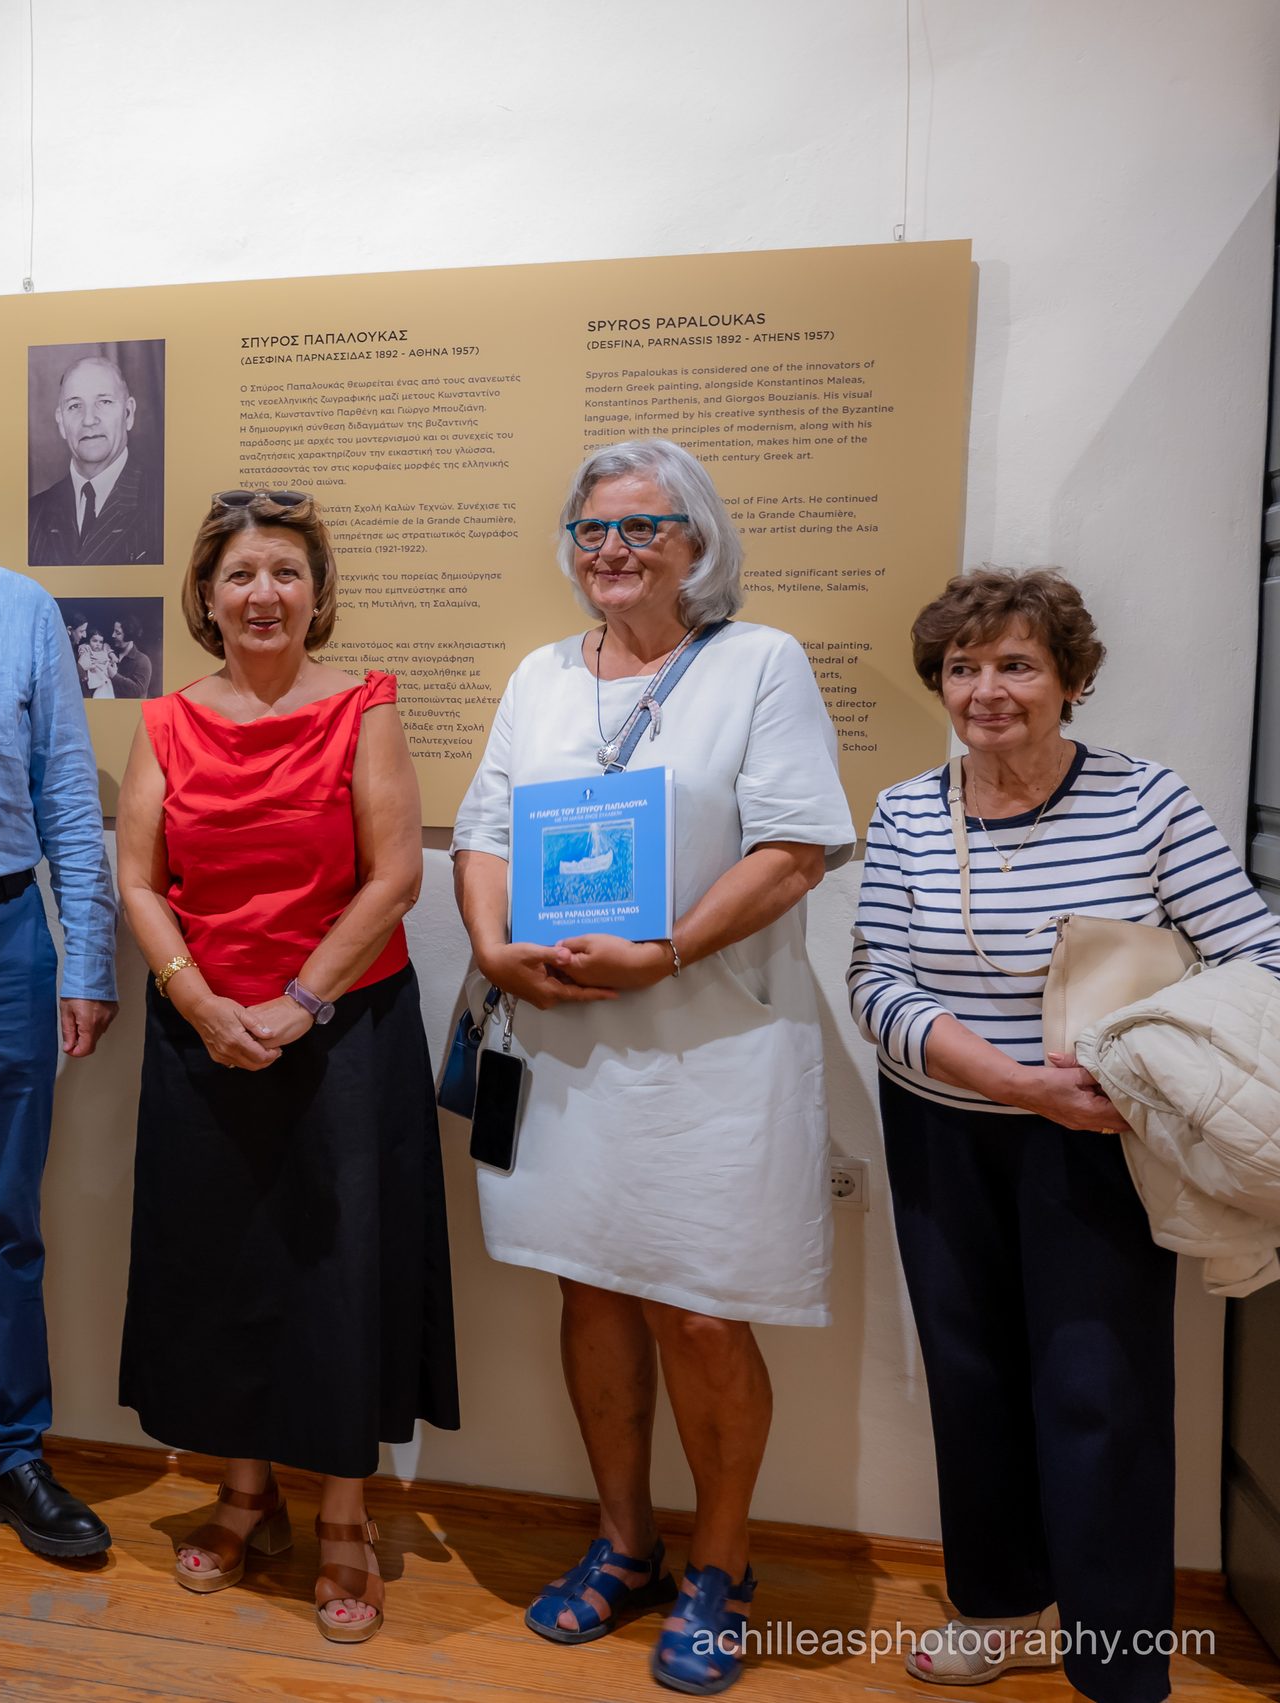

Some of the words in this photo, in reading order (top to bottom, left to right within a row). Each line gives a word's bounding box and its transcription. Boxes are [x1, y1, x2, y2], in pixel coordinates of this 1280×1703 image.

[586, 318, 650, 332] SPYROS
[656, 312, 766, 329] PAPALOUKAS
[240, 334, 299, 348] ΣΠΥΡΟΣ
[304, 329, 408, 345] ΠΑΠΑΛΟΥΚΑΣ
[586, 339, 644, 350] (DESFINA,
[647, 335, 712, 346] PARNASSIS
[716, 334, 741, 344] 1892
[752, 332, 800, 342] ATHENS
[804, 330, 834, 340] 1957)
[240, 354, 292, 365] (ΔΕΣΦΙΝΑ
[295, 350, 372, 362] ΠΑΡΝΑΣΣΙΔΑΣ
[375, 349, 398, 358] 1892
[408, 347, 448, 357] ΑΘΗΝΑ
[451, 346, 479, 355] 1957)
[584, 370, 619, 380] Spyros
[621, 367, 678, 378] Papaloukas
[680, 367, 688, 375] is
[691, 364, 747, 375] considered
[772, 363, 783, 372] of
[786, 362, 803, 371] the
[805, 361, 860, 370] innovators
[863, 359, 875, 368] of
[239, 384, 248, 392] Ο
[396, 378, 418, 387] ένας
[420, 377, 440, 385] από
[584, 384, 623, 393] modern
[625, 382, 655, 391] Greek
[657, 381, 702, 392] painting,
[704, 379, 754, 390] alongside
[756, 377, 824, 387] Konstantinos
[826, 376, 865, 384] Maleas,
[239, 399, 255, 407] της
[378, 392, 399, 402] μαζί
[584, 398, 648, 407] Konstantinos
[651, 396, 700, 405] Parthenis,
[702, 394, 722, 403] and
[724, 394, 765, 403] Giorgos
[768, 392, 820, 401] Bouzianis.
[823, 391, 839, 399] His
[842, 390, 872, 399] visual
[584, 414, 631, 423] language,
[634, 410, 679, 420] informed
[682, 410, 695, 420] by
[697, 410, 712, 418] his
[714, 408, 755, 418] creative
[758, 407, 805, 418] synthesis
[807, 406, 819, 415] of
[821, 405, 838, 414] the
[841, 404, 894, 415] Byzantine
[583, 427, 625, 436] tradition
[628, 426, 650, 435] with
[652, 426, 669, 434] the
[671, 424, 720, 435] principles
[723, 423, 734, 432] of
[736, 422, 796, 431] modernism,
[799, 421, 828, 430] along
[831, 420, 854, 428] with
[857, 420, 872, 428] his
[293, 438, 304, 446] με
[756, 437, 789, 445] makes
[792, 436, 811, 445] him
[836, 435, 848, 443] of
[850, 435, 868, 443] the
[721, 453, 760, 462] century
[763, 451, 794, 460] Greek
[796, 451, 814, 459] art.
[330, 464, 349, 472] στις
[442, 461, 459, 469] της
[290, 477, 314, 486] 20ού
[769, 524, 796, 533] artist
[799, 524, 832, 534] during
[835, 524, 853, 532] the
[855, 523, 878, 532] Asia
[385, 532, 399, 540] ως
[743, 568, 782, 577] created
[784, 568, 838, 578] significant
[840, 568, 871, 576] series
[874, 567, 886, 576] of
[742, 583, 774, 592] Athos,
[777, 583, 823, 592] Mytilene,
[826, 582, 868, 591] Salamis,
[827, 641, 872, 651] painting,
[835, 699, 877, 708] director
[842, 742, 877, 751] School
[617, 906, 640, 915] PAROS
